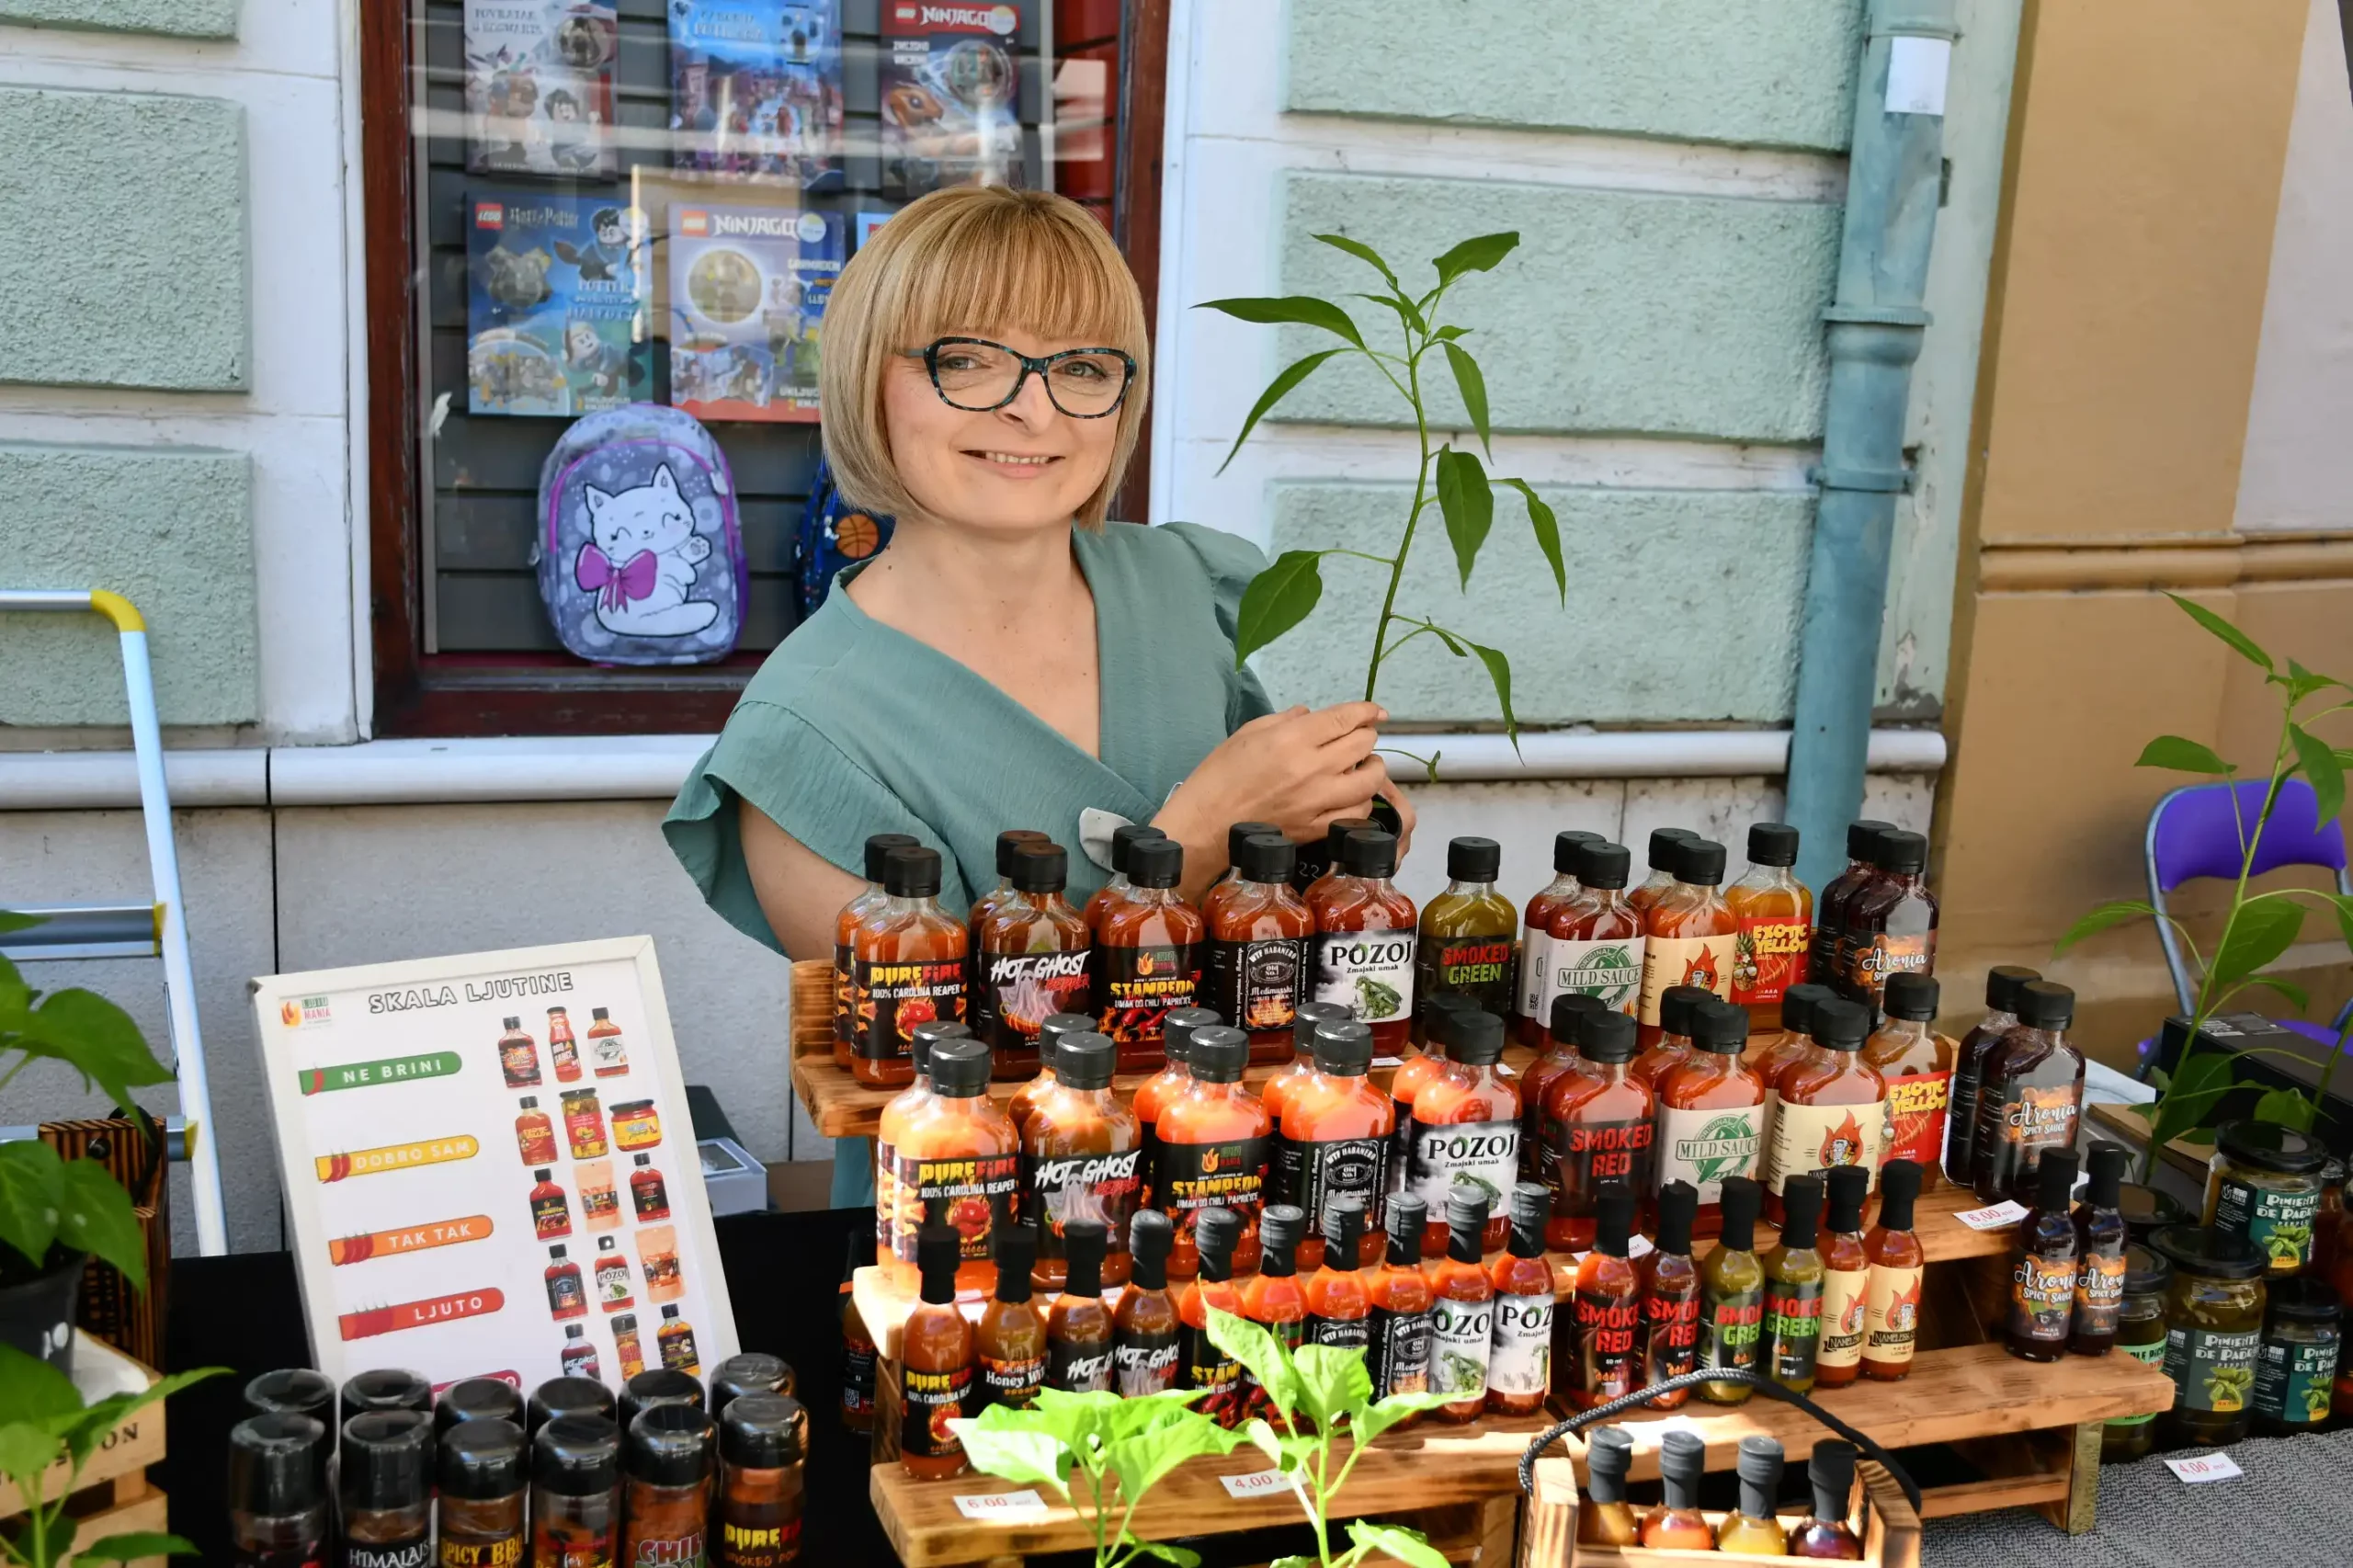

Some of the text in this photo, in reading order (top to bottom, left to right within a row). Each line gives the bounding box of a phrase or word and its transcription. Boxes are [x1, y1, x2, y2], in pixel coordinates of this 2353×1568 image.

[1753, 923, 1808, 939] EXOTIC
[1264, 946, 1297, 960] HABANERO
[1330, 939, 1413, 965] POZOJ
[1441, 944, 1509, 965] SMOKED
[1754, 938, 1809, 955] YELLOW
[990, 950, 1092, 983] HOT GHOST
[1347, 964, 1399, 974] Zmajski umak
[1862, 948, 1928, 970] Aronia
[1448, 963, 1502, 985] GREEN
[1561, 968, 1641, 985] MILD SAUCE
[369, 971, 574, 1014] SKALA LJUTINE
[872, 983, 961, 999] 100% CAROLINA REAPER
[1115, 999, 1134, 1009] UMAK
[1144, 997, 1160, 1008] CHILI
[343, 1059, 443, 1083] NE BRINI
[1889, 1078, 1947, 1100] EXOTIC
[1891, 1094, 1948, 1115] YELLOW
[2010, 1101, 2077, 1126] Aronia
[1569, 1123, 1653, 1153] SMOKED
[2022, 1122, 2066, 1137] SPICY SAUCE
[355, 1141, 472, 1171] DOBRO SAM
[1342, 1146, 1377, 1161] HABANERO
[1428, 1132, 1516, 1160] POZOJ
[1680, 1136, 1760, 1158] MILD SAUCE
[1035, 1150, 1142, 1188] HOT GHOST
[1444, 1157, 1500, 1169] Zmajski umak
[1591, 1152, 1631, 1177] RED
[921, 1178, 1015, 1199] 100% CAROLINA REAPER
[1176, 1199, 1199, 1209] UMAK
[2267, 1194, 2319, 1207] PIMIENT
[2256, 1207, 2278, 1219] DE
[388, 1223, 472, 1249] TAK TAK
[2014, 1260, 2075, 1289] Aroni
[2022, 1287, 2047, 1301] SPICY
[2088, 1288, 2109, 1299] SPICY
[415, 1295, 483, 1322] LJUTO
[1501, 1303, 1552, 1329] POZ
[1433, 1307, 1491, 1335] OZO
[1767, 1312, 1820, 1337] GREEN
[1596, 1330, 1633, 1353] RED
[2205, 1334, 2259, 1347] PIMIENT
[1115, 1343, 1150, 1370] HOT
[2195, 1348, 2216, 1359] DE
[1067, 1357, 1104, 1379] HOT
[2294, 1362, 2313, 1371] DE
[985, 1370, 1025, 1388] Honey
[923, 1390, 960, 1404] CAROLINA
[1235, 1474, 1273, 1489] 4,00
